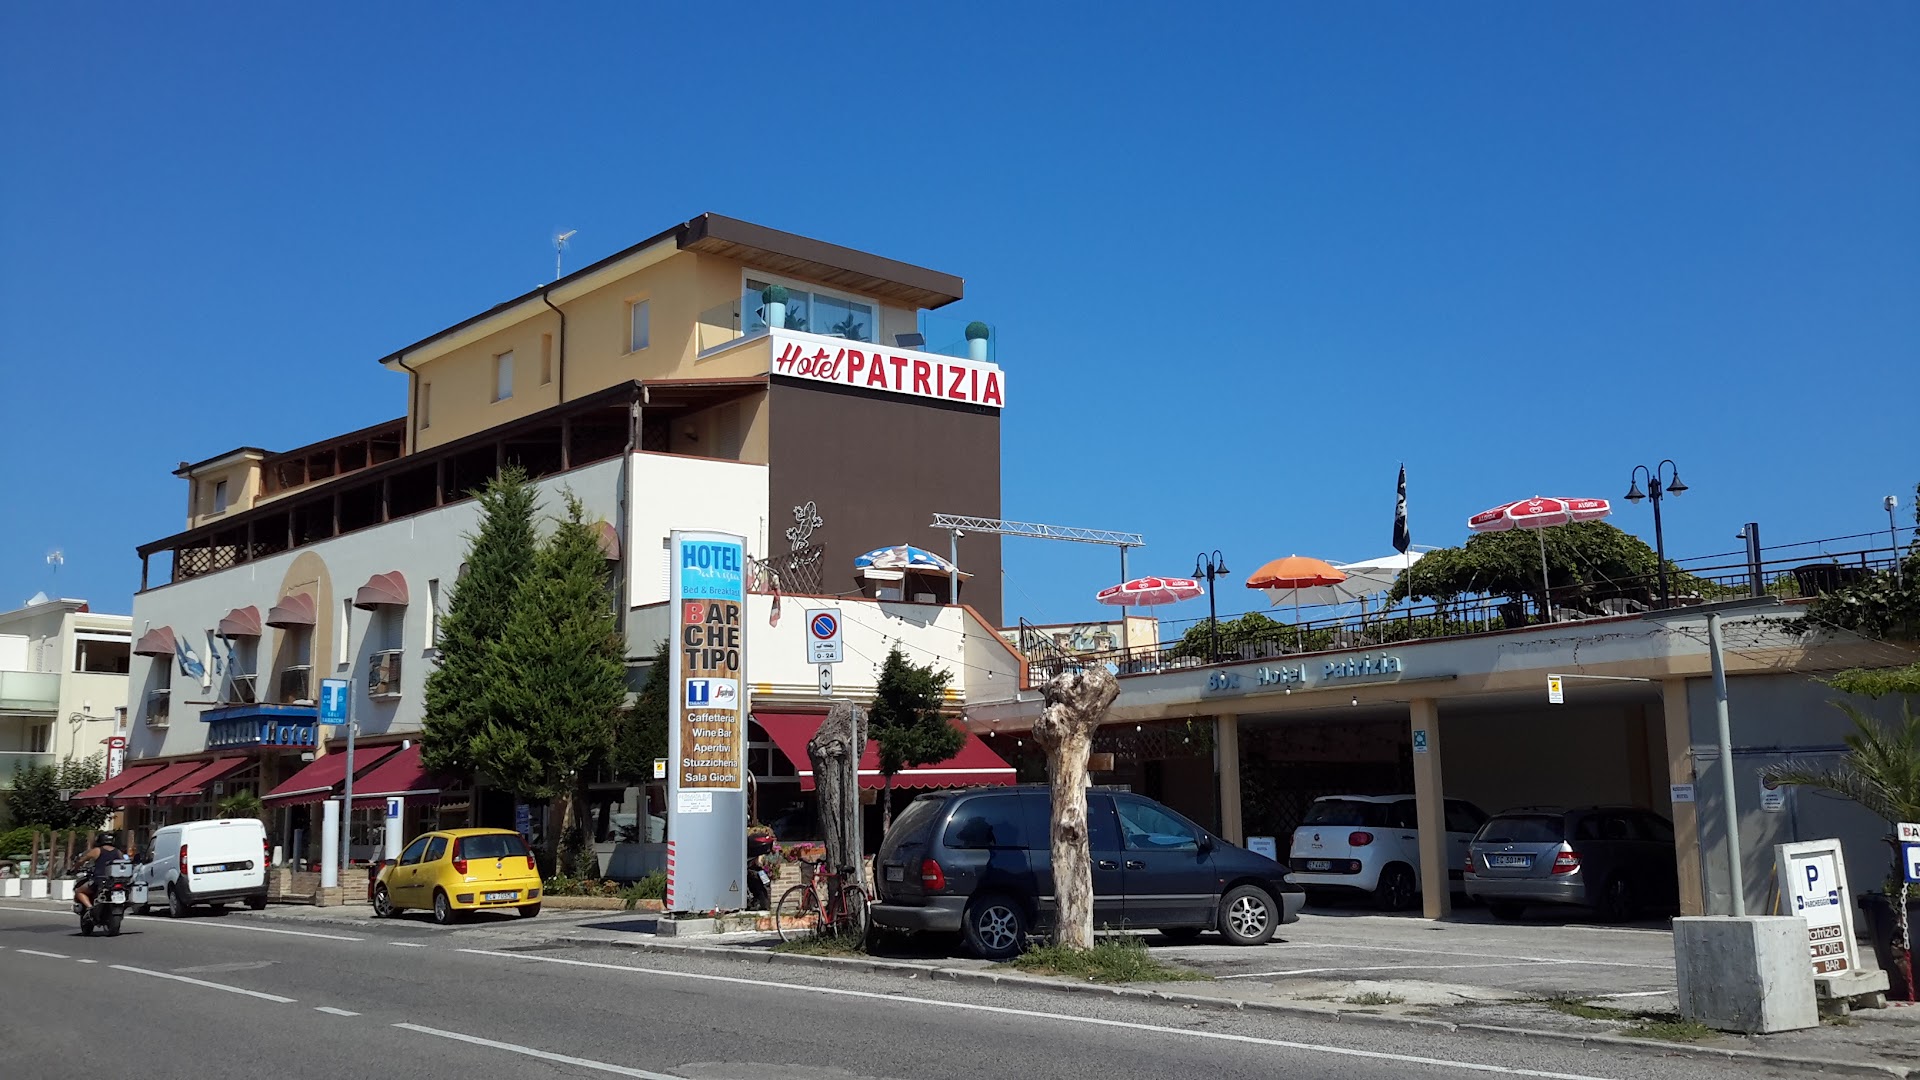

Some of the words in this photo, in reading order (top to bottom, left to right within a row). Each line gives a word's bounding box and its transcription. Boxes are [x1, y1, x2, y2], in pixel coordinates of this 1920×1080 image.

[776, 342, 845, 381] Hotel
[847, 350, 1002, 406] PATRIZIA
[682, 544, 741, 572] HOTEL
[683, 585, 699, 594] Bed
[701, 586, 707, 594] &
[709, 586, 741, 597] Breakfast
[685, 602, 739, 626] BAR
[684, 625, 740, 649] CHE
[685, 648, 740, 671] TIPO
[1257, 662, 1307, 686] Hotel
[1322, 651, 1402, 680] Patrizia
[692, 681, 706, 701] T
[687, 713, 736, 723] Caffetteria
[692, 728, 717, 738] Wine
[717, 728, 732, 738] Bar
[693, 743, 731, 753] Aperitivi
[683, 758, 738, 768] Stuzzicheria
[685, 773, 707, 782] Sala
[709, 773, 736, 783] Giochi
[1805, 865, 1819, 892] P
[1808, 926, 1841, 941] atrizia
[1818, 942, 1842, 956] HOTEL
[1824, 959, 1841, 972] BAR
